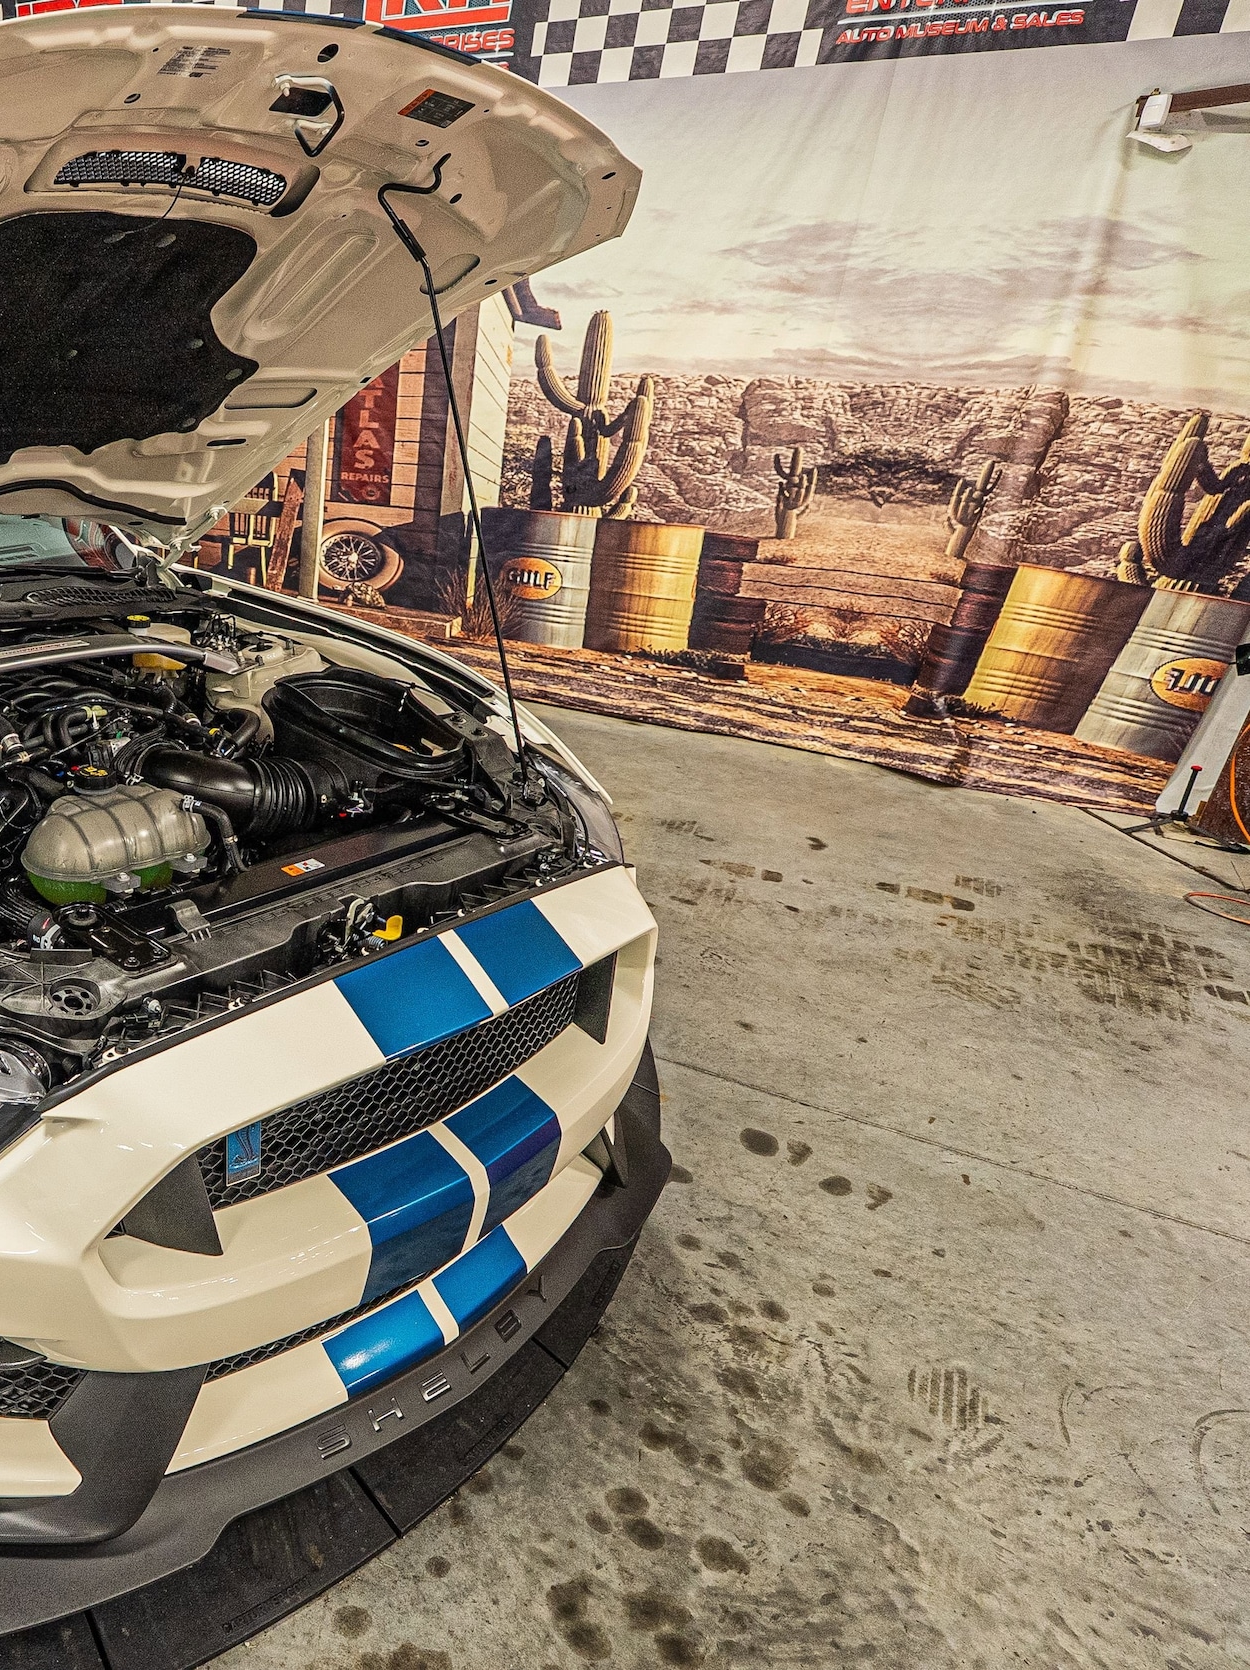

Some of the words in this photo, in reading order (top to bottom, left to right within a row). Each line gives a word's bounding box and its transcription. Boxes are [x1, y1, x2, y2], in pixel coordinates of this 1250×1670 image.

[835, 26, 894, 45] AUTO
[895, 16, 989, 40] MUSEUM
[990, 15, 1008, 33] &
[1009, 9, 1086, 31] SALES
[340, 472, 390, 484] REPAIRS
[507, 568, 556, 591] GULF
[316, 1274, 547, 1460] SHELBY
